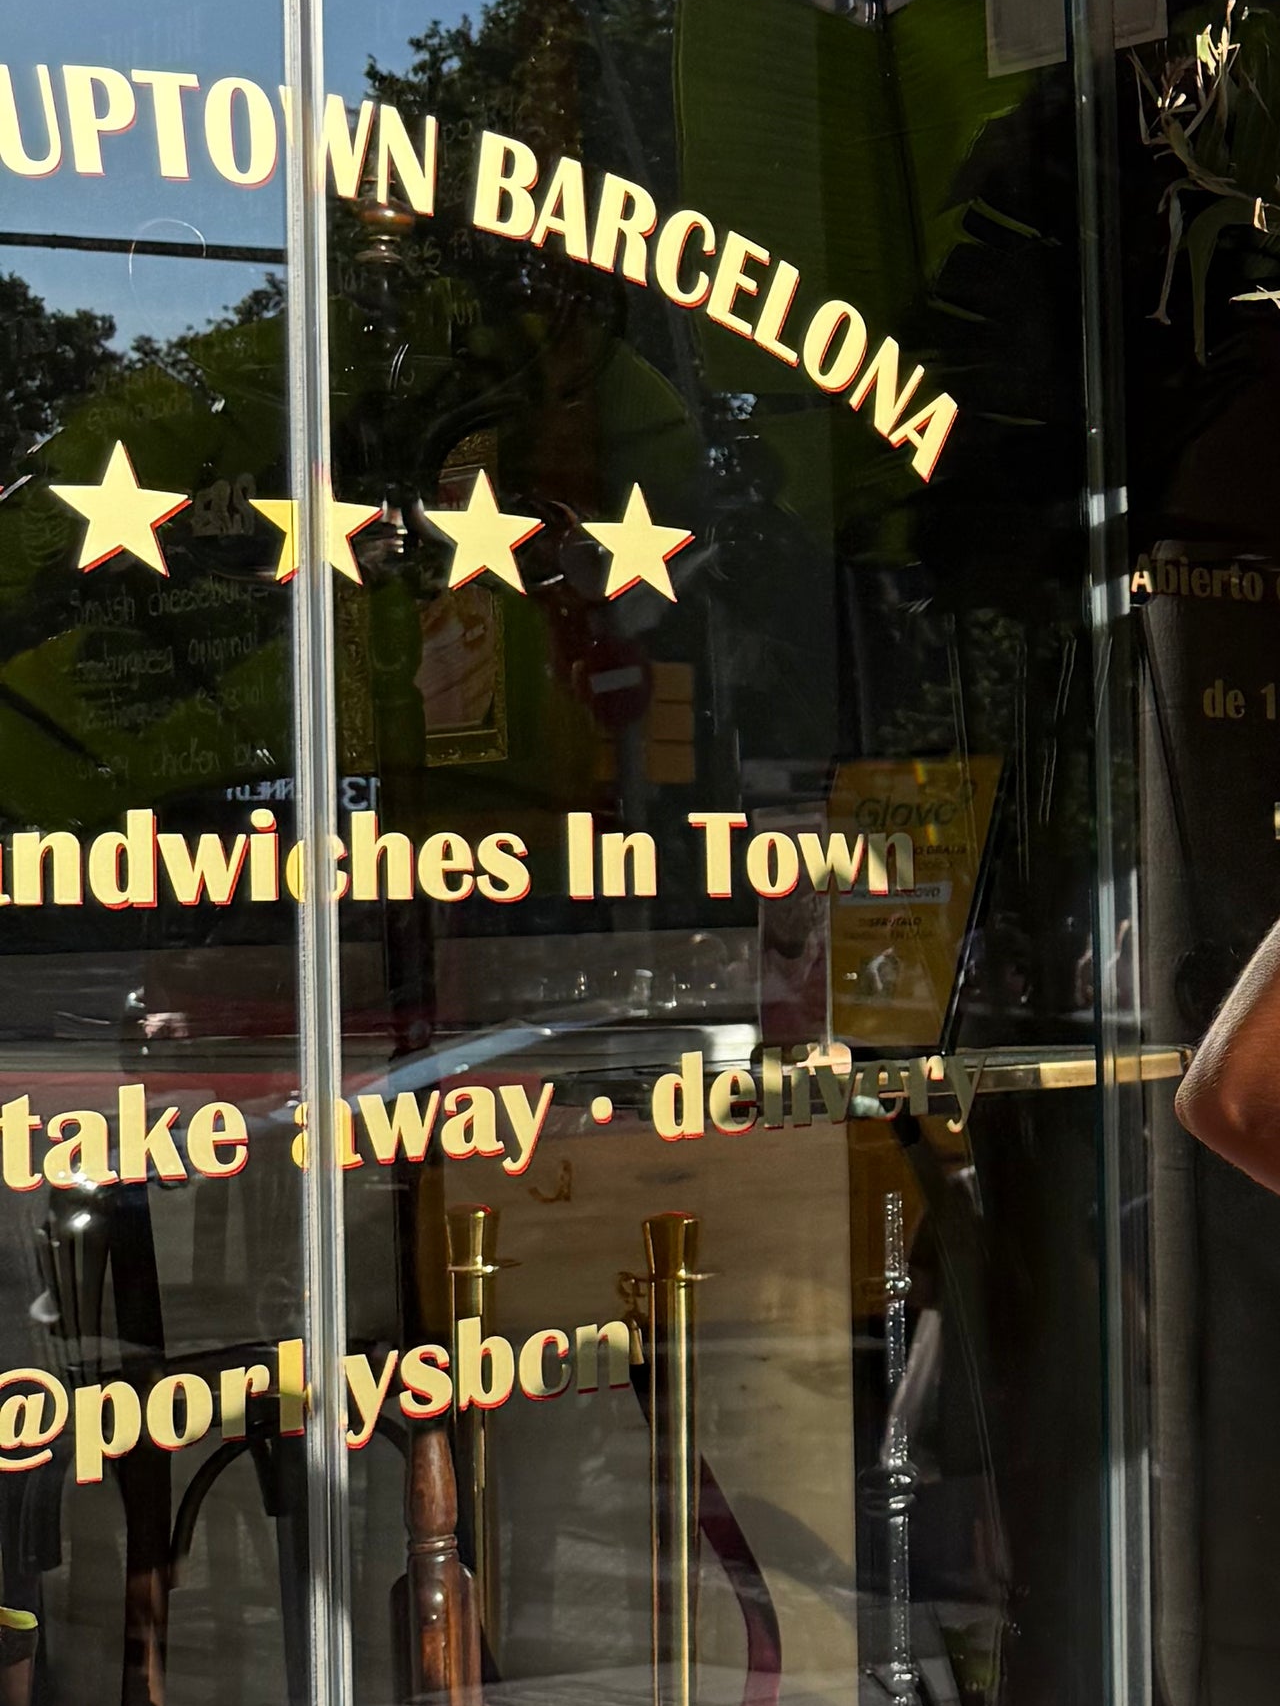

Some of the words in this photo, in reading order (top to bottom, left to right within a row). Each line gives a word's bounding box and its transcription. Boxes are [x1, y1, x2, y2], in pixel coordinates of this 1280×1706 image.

[473, 130, 959, 485] BARCELONA
[1130, 553, 1264, 601] Abierto
[1202, 679, 1246, 720] de
[0, 808, 532, 910] ndwihes
[568, 811, 659, 901] In
[687, 812, 915, 900] Town
[0, 1083, 250, 1192] take
[651, 1041, 987, 1143] delivery
